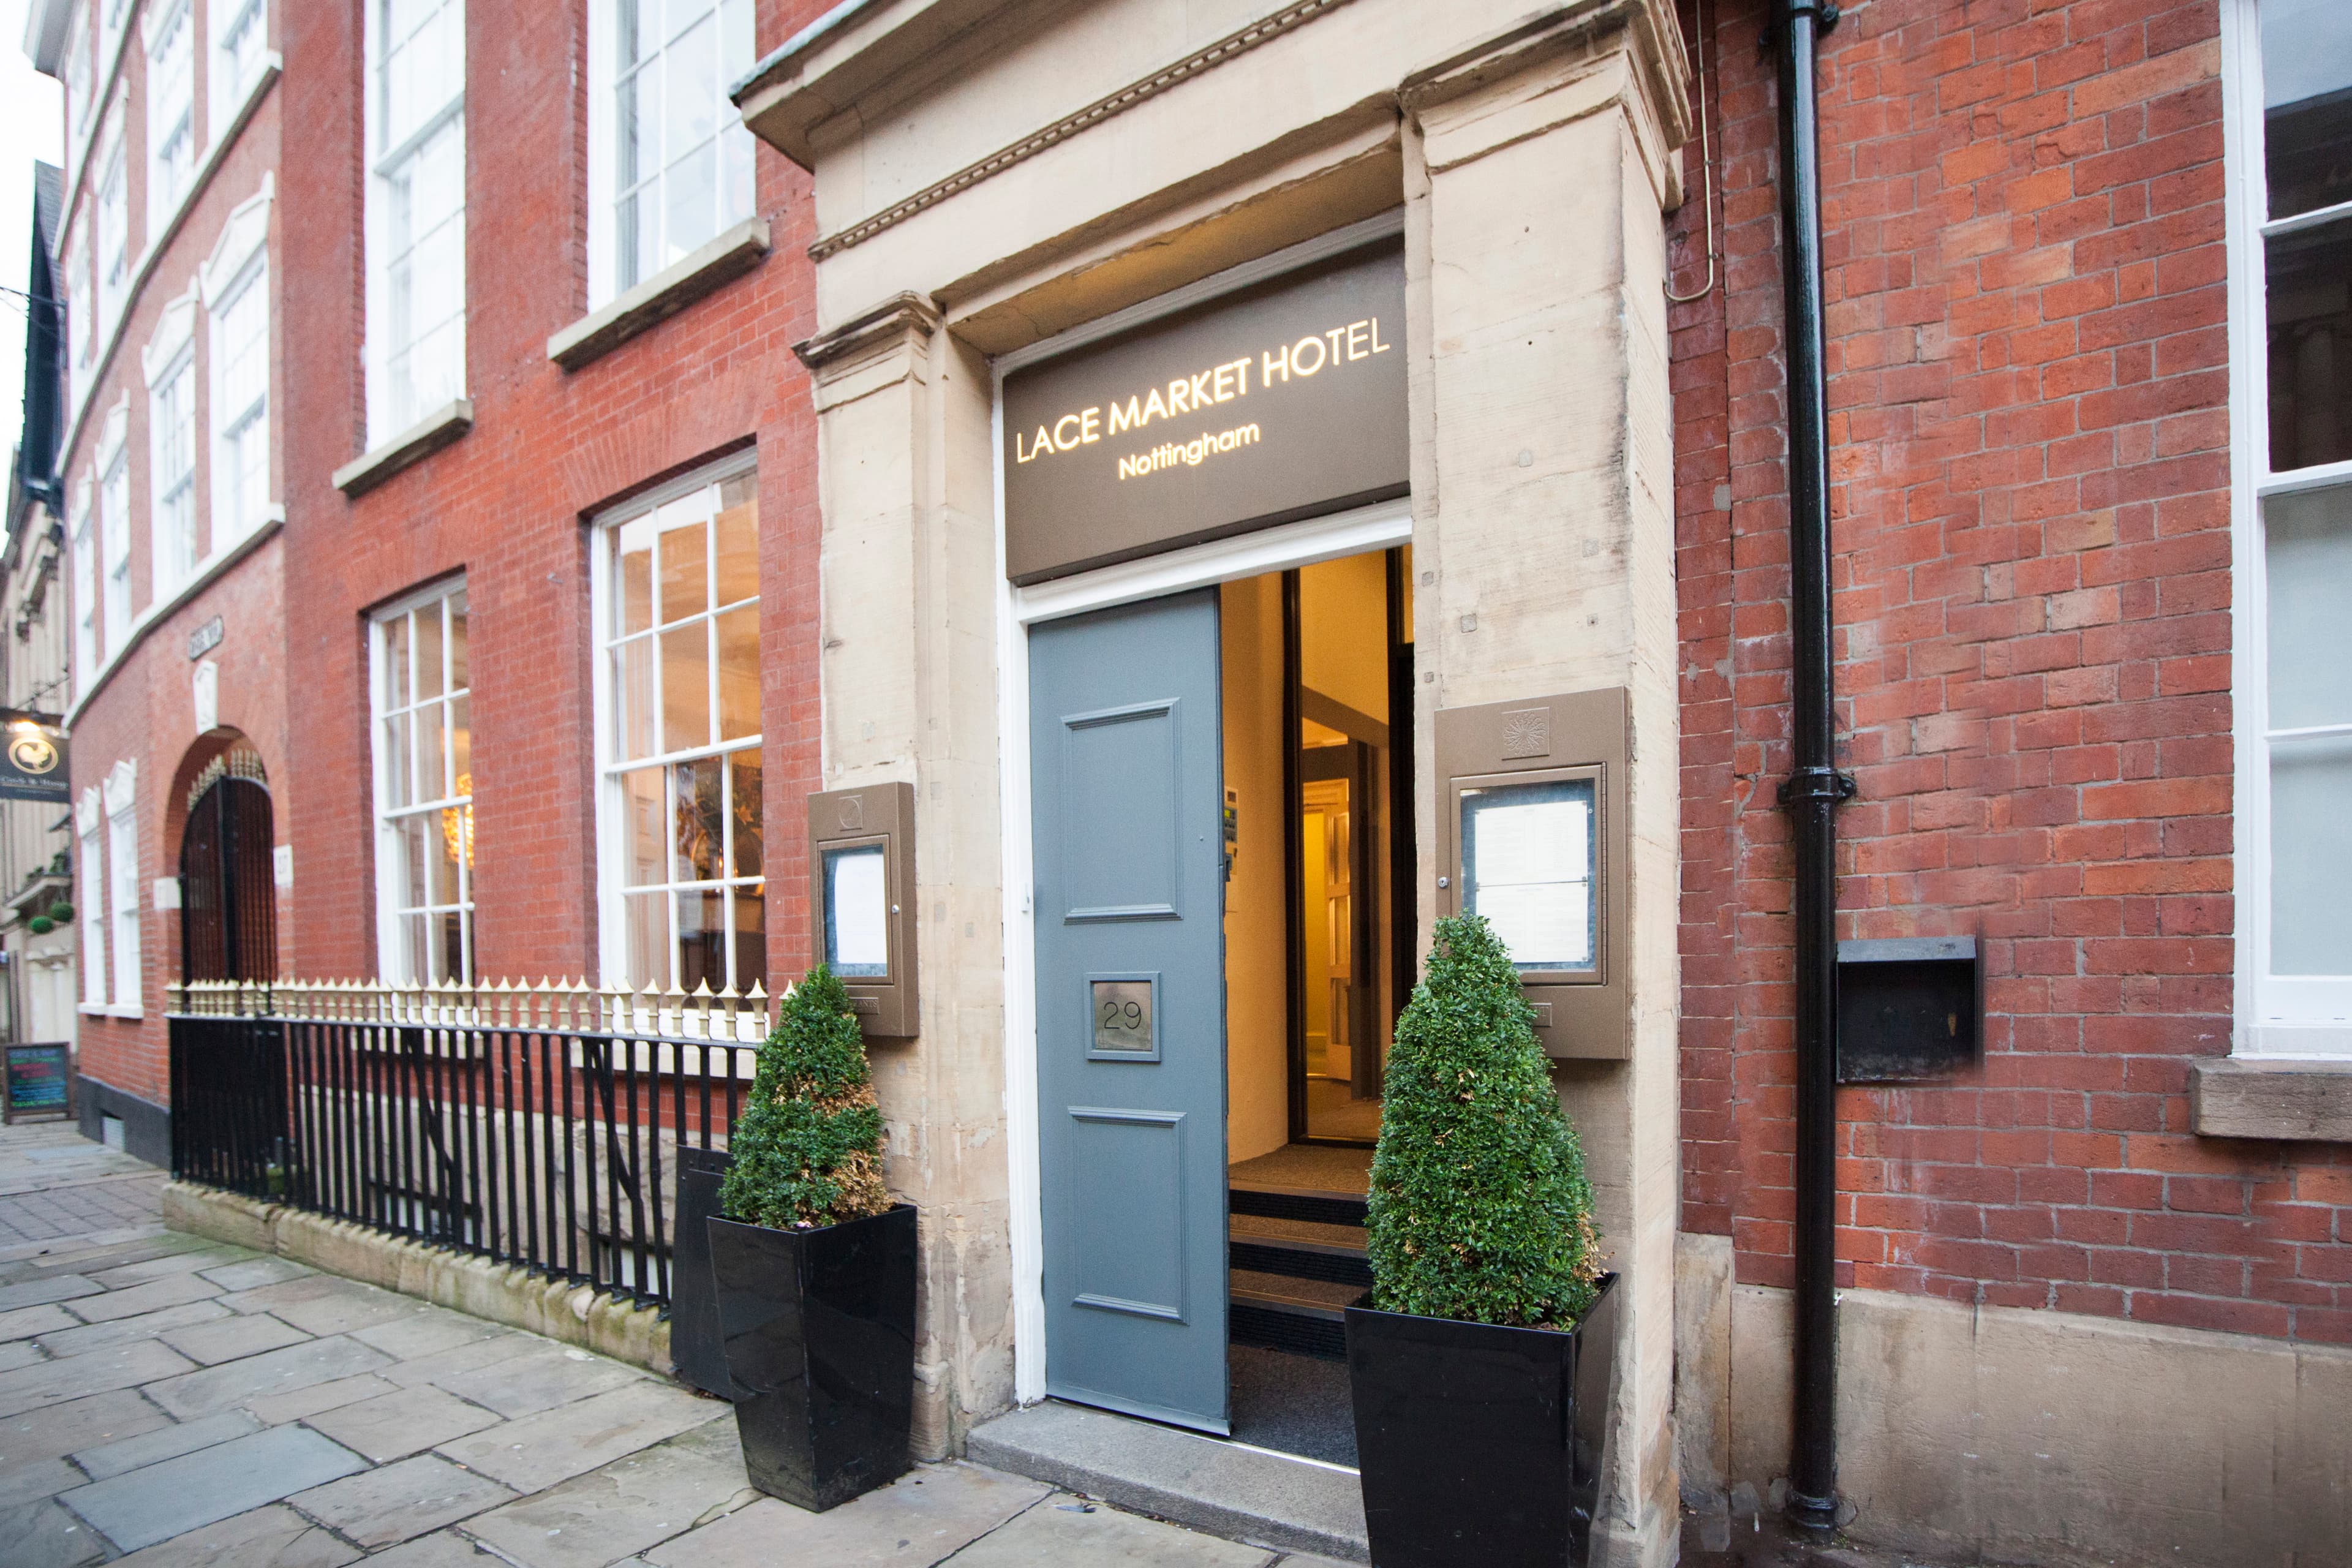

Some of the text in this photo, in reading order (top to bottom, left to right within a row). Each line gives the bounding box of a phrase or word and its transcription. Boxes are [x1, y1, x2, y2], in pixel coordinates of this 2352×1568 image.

[1017, 317, 1390, 463] LACE MARKET HOTEL
[1118, 423, 1261, 480] Nottingham
[1104, 1001, 1142, 1030] 29
